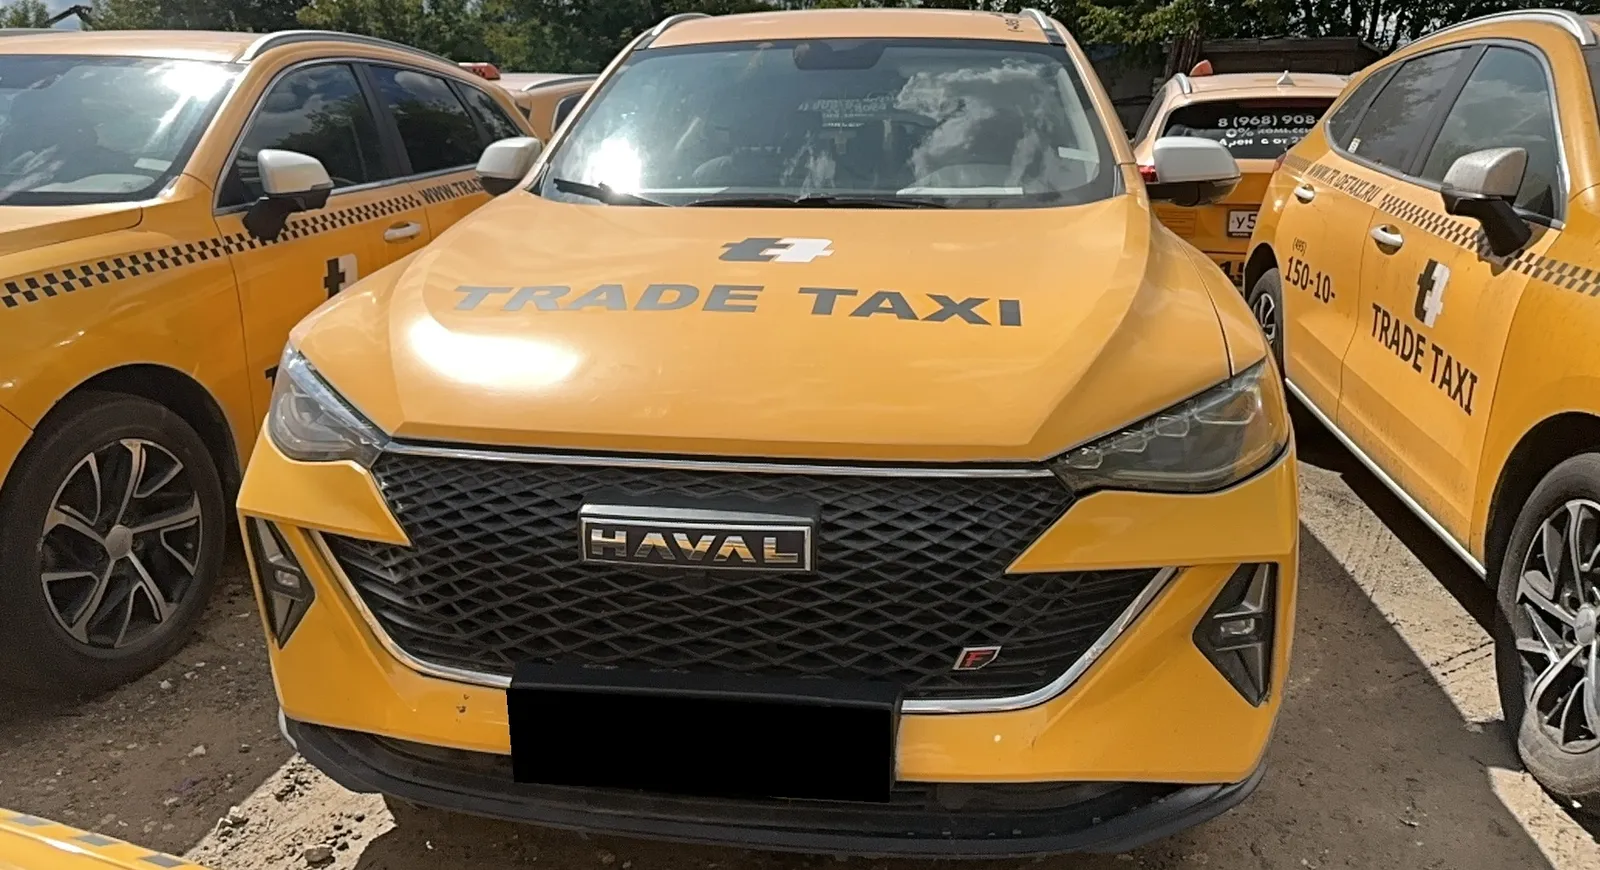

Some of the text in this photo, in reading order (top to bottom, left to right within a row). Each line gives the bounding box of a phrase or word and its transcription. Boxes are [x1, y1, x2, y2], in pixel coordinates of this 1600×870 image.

[1218, 118, 1228, 128] 8
[1233, 115, 1278, 128] (968)
[1225, 128, 1254, 138] 0%
[1285, 256, 1335, 304] 150-10-
[453, 284, 1022, 326] TRADE TAXI
[1371, 302, 1478, 416] TRADE TAXI
[591, 528, 798, 563] HAVAL
